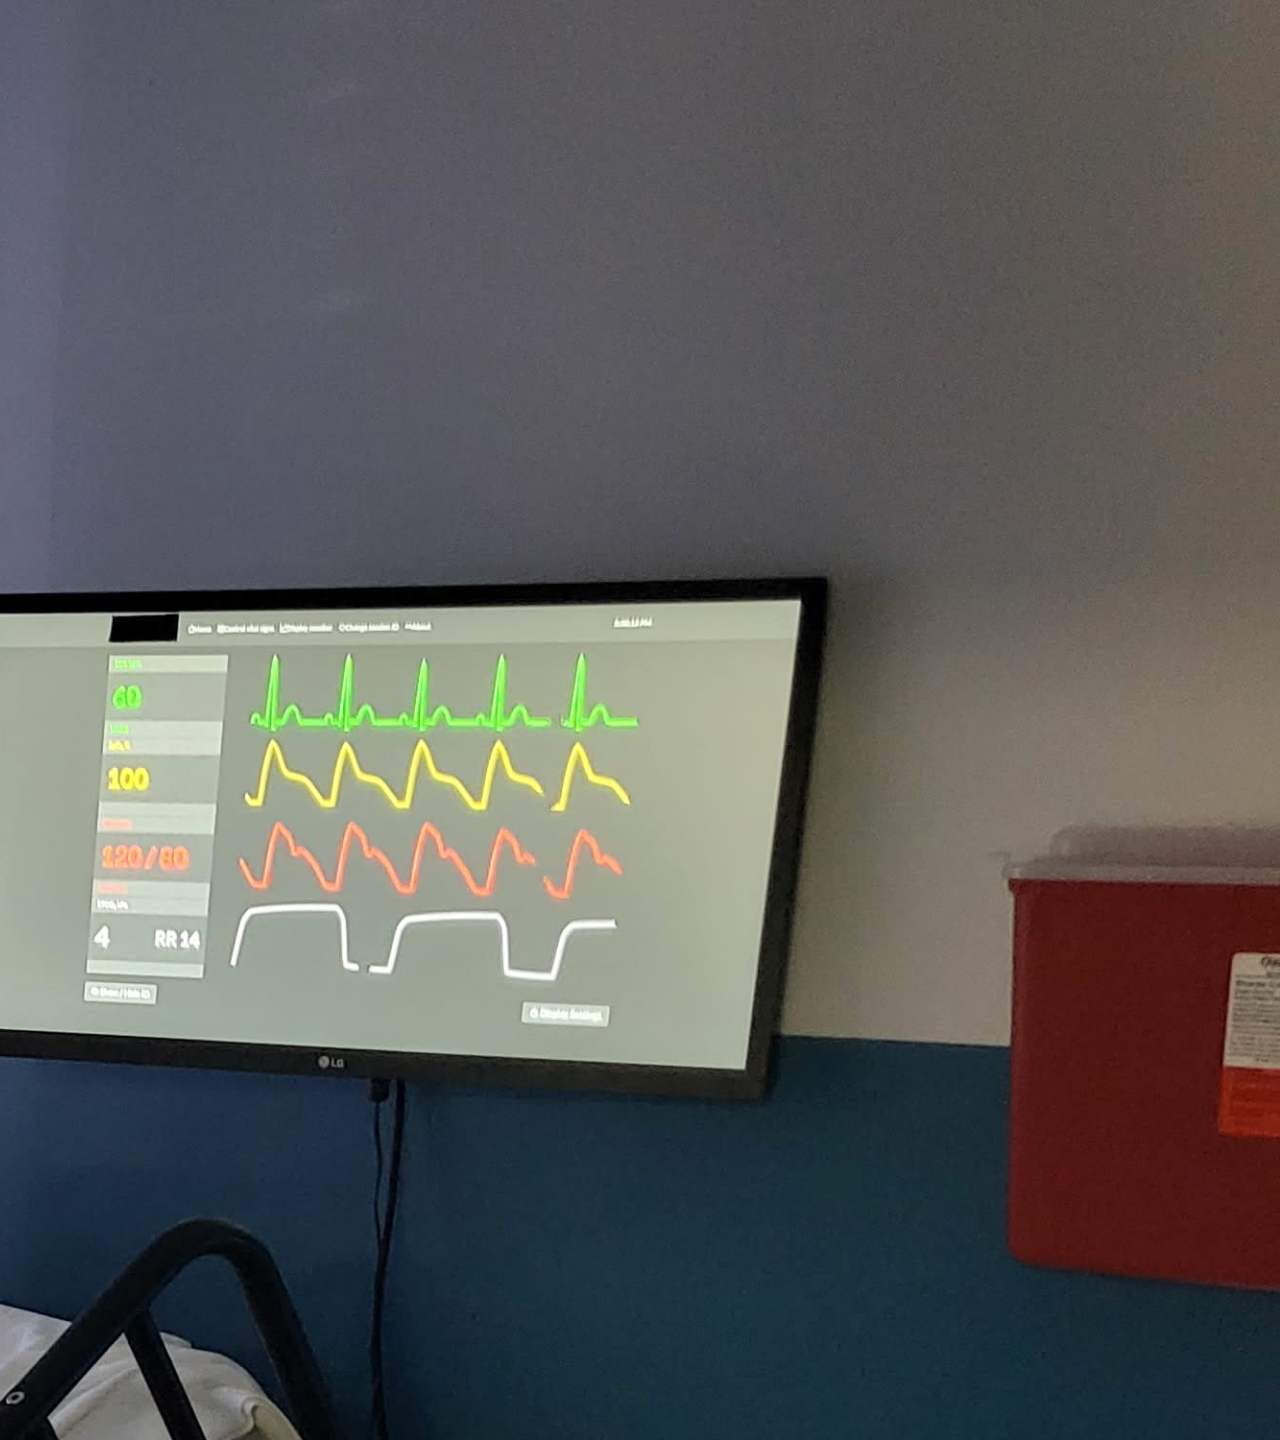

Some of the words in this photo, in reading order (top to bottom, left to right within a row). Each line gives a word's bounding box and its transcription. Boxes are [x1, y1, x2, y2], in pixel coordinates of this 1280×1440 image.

[112, 685, 142, 710] 60
[107, 766, 150, 791] 100
[101, 844, 190, 871] 120/80
[93, 924, 111, 950] 4
[154, 928, 178, 949] RR
[179, 929, 201, 950] 14
